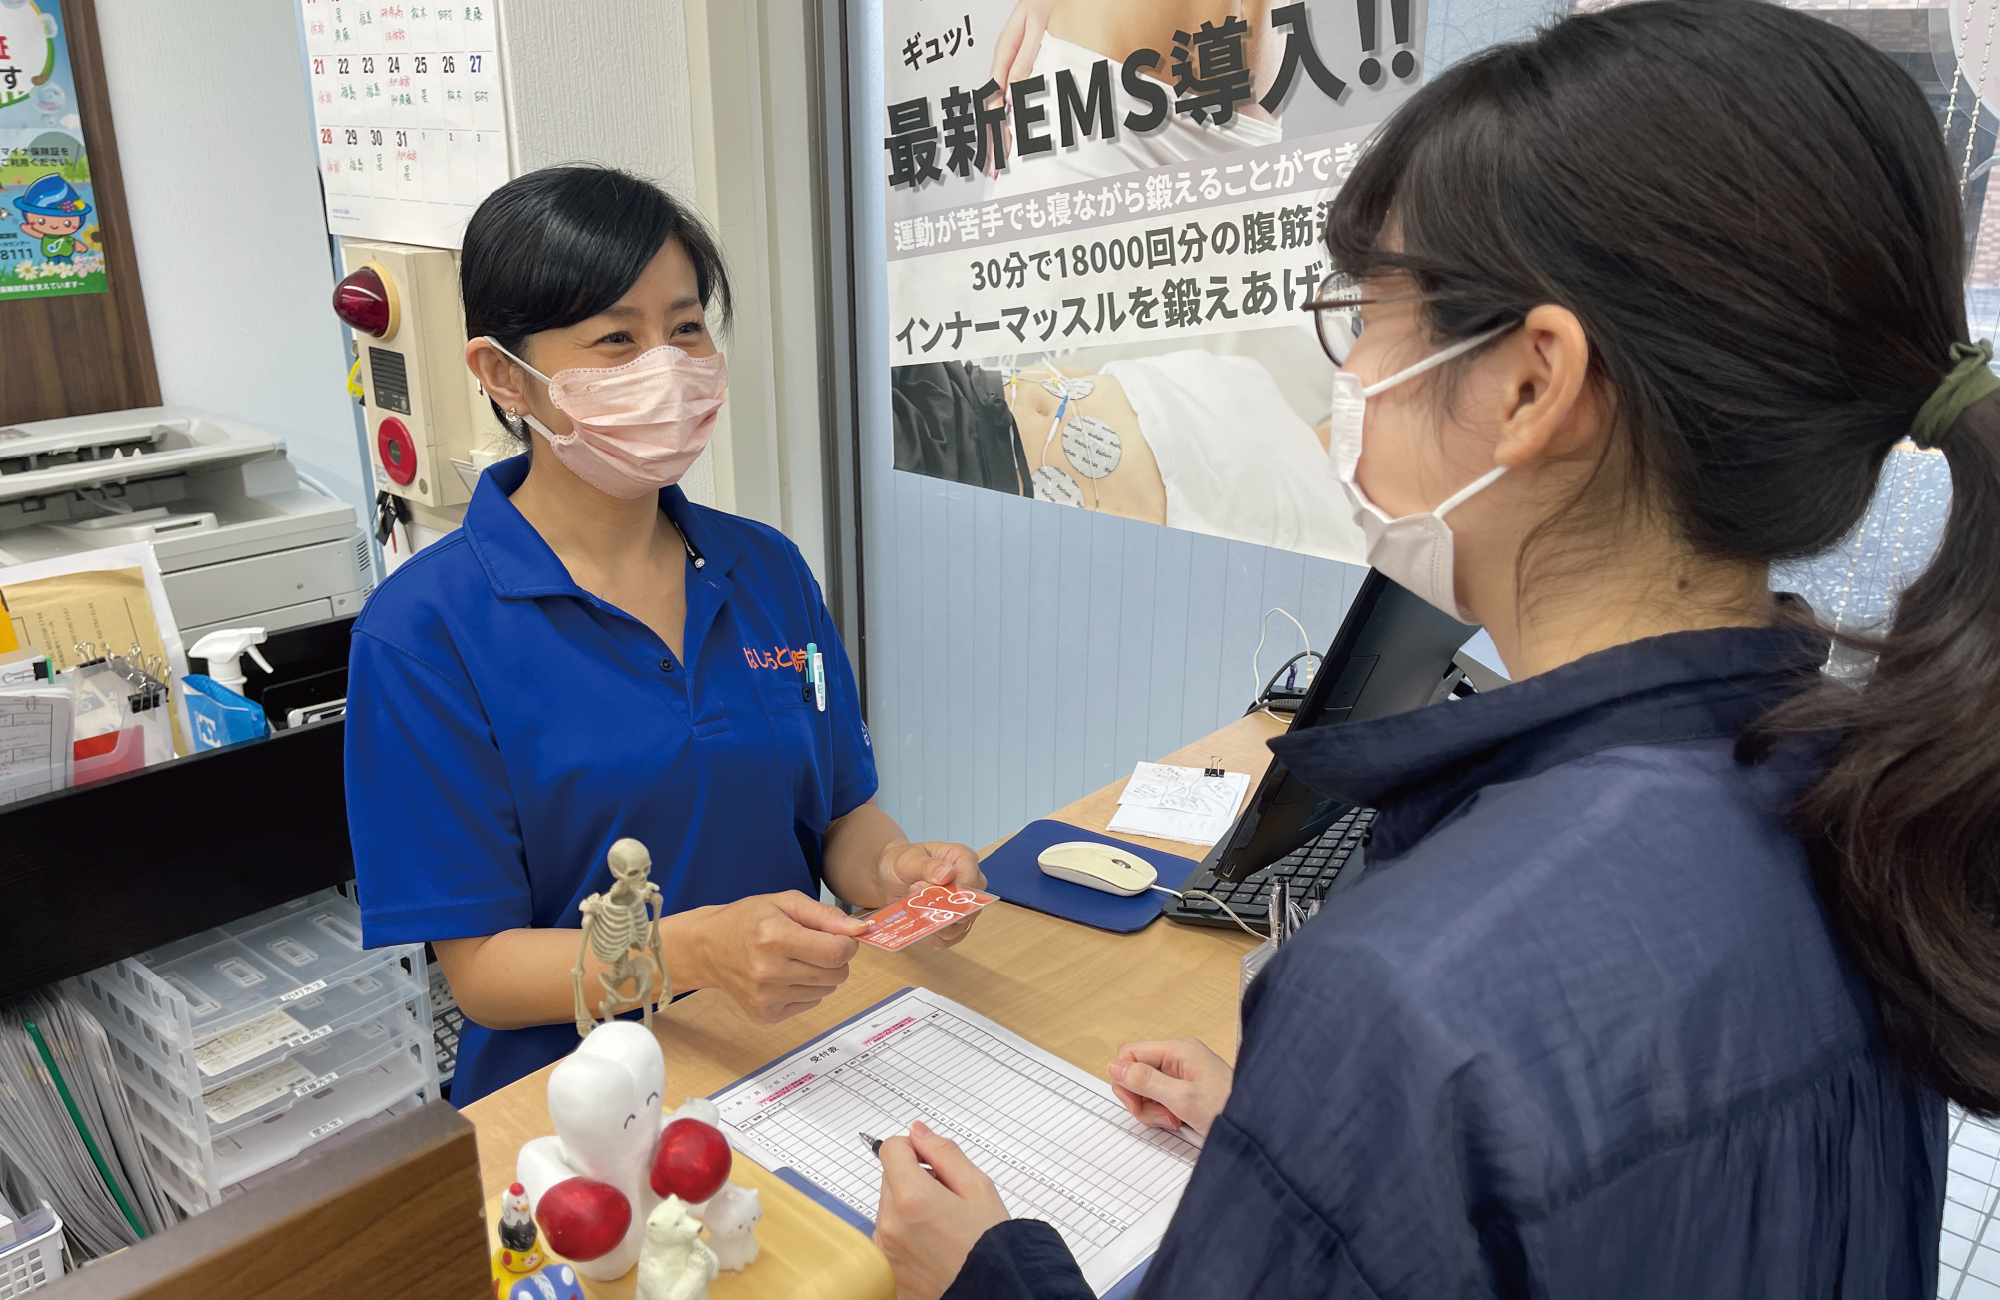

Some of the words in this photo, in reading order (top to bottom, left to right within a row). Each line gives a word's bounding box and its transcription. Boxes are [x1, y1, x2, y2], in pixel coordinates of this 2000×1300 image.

[313, 58, 325, 75] 21
[337, 58, 350, 75] 22
[362, 56, 375, 74] 23
[387, 56, 400, 74] 24
[414, 56, 428, 74] 25
[442, 55, 455, 74] 26
[469, 54, 482, 74] 27
[902, 14, 974, 71] ギュッ!
[884, 0, 1415, 188] 最新EMS導入!!
[320, 128, 333, 145] 28
[345, 129, 358, 146] 29
[370, 129, 383, 146] 30
[396, 130, 408, 148] 31
[894, 139, 1372, 252] 運動が苦手でも寝ながら鍛えることができ
[897, 259, 1337, 356] インナーマッスルを鍛えあげ
[810, 1045, 840, 1064] 受付表
